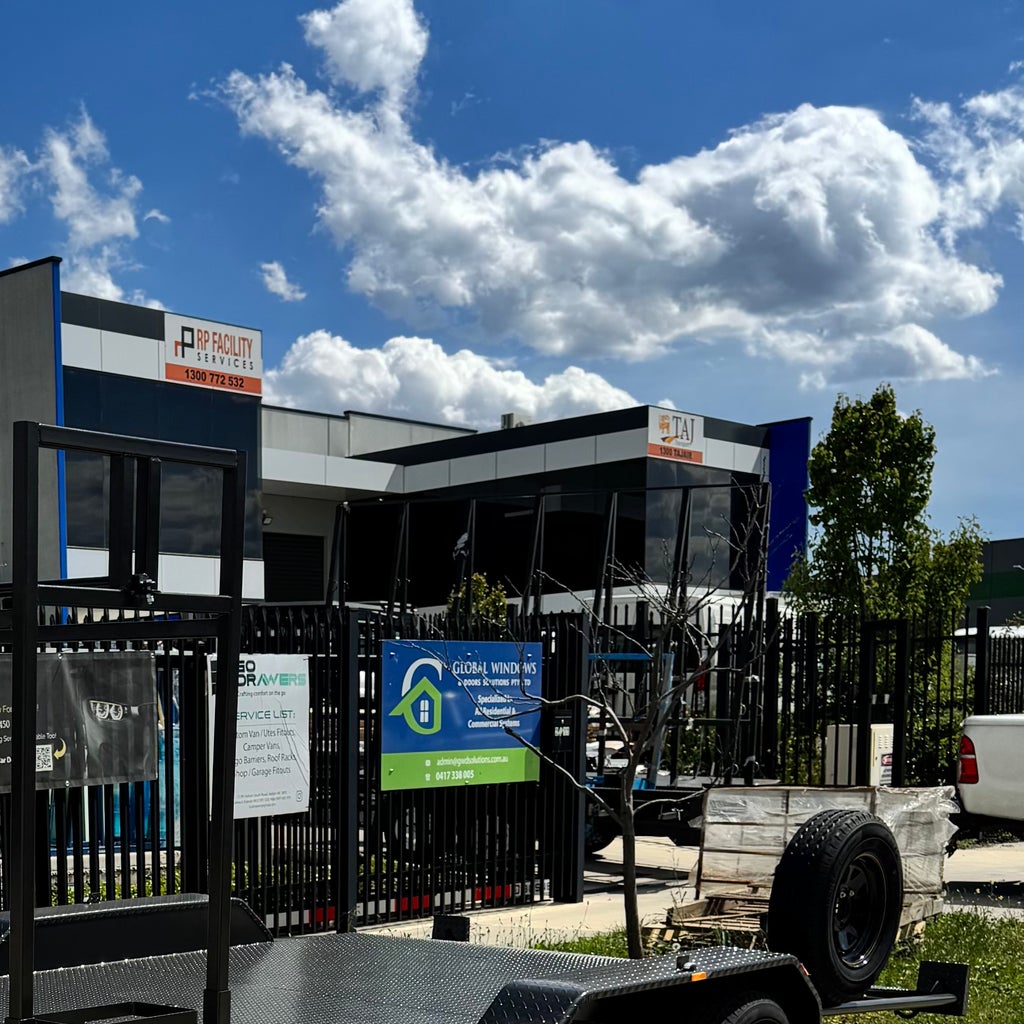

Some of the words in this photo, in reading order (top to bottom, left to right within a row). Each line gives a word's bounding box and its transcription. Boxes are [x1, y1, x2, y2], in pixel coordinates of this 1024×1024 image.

[197, 329, 209, 351] RP
[212, 331, 253, 359] FACILITY
[197, 352, 254, 370] SERVICES
[184, 368, 206, 382] 1300
[209, 373, 226, 385] 772
[228, 376, 244, 388] 532
[673, 416, 695, 444] TAJ
[453, 661, 487, 674] GLOBAL
[482, 679, 510, 687] SOUTIONS
[236, 710, 271, 720] ERVICE
[243, 742, 266, 751] Camper
[436, 771, 450, 780] 0417
[451, 770, 463, 780] 338
[463, 770, 474, 779] 005
